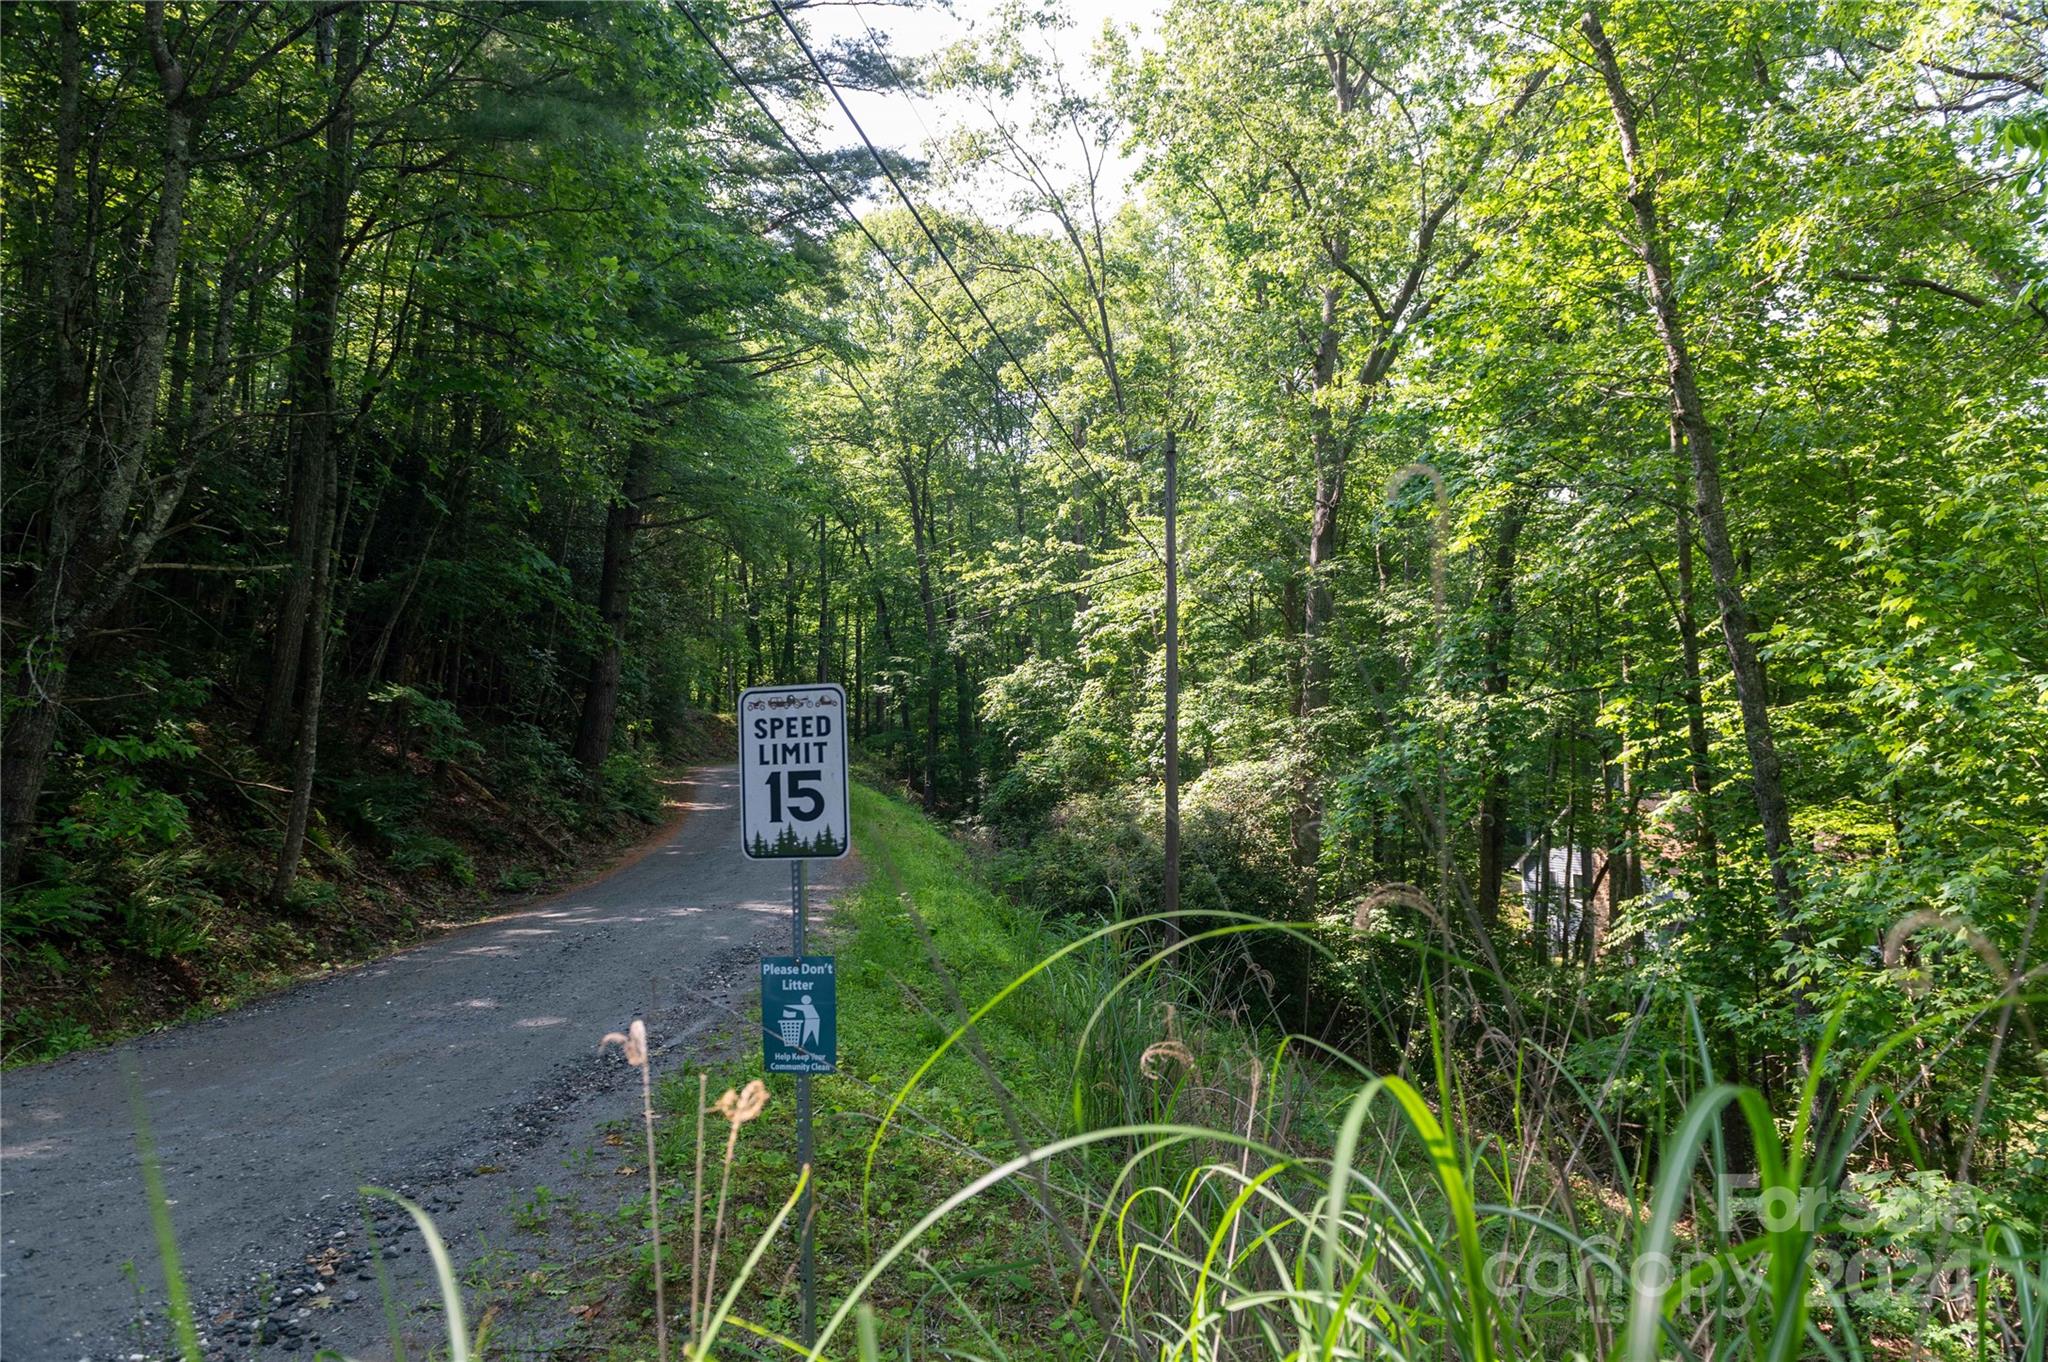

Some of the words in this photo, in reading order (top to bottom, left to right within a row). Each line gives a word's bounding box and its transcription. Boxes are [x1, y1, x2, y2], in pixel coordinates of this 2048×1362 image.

[754, 715, 831, 739] SPEED
[759, 742, 828, 765] LIMIT
[765, 770, 825, 823] 15
[763, 964, 799, 975] Please
[801, 963, 833, 975] Don't
[782, 979, 814, 991] Litter
[774, 1052, 791, 1062] Help
[770, 1062, 810, 1072] Community
[811, 1062, 830, 1071] Clean
